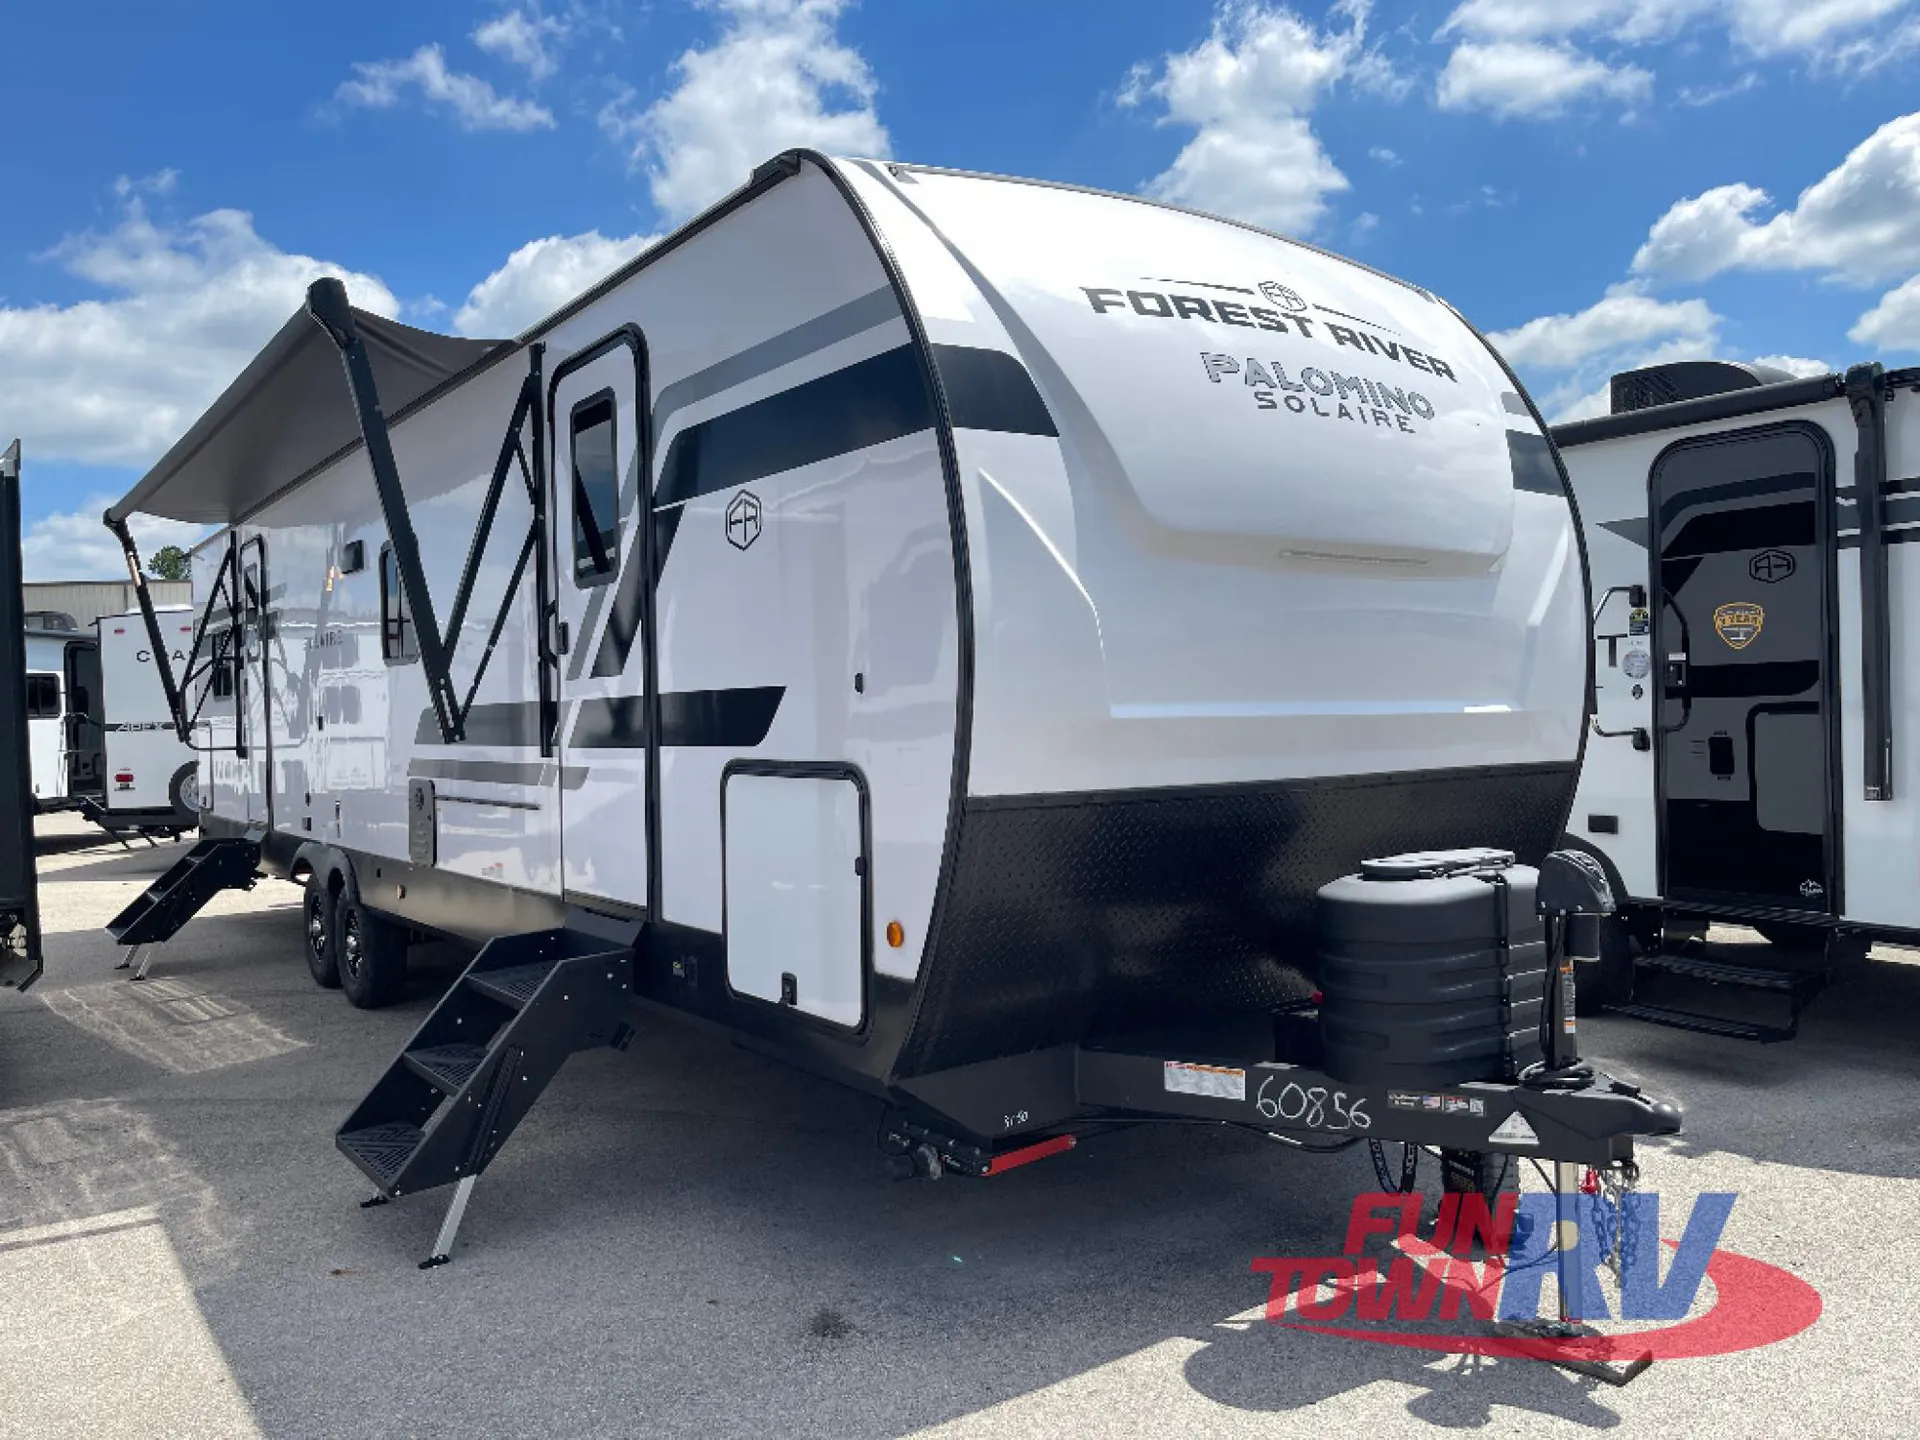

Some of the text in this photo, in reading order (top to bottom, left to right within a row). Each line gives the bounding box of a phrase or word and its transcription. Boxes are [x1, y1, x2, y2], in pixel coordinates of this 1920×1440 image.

[1080, 286, 1458, 383] FOREST RIVER
[1200, 351, 1435, 420] PALOMINO
[1253, 390, 1416, 434] SOLAIRE
[1256, 1075, 1371, 1129] 60856
